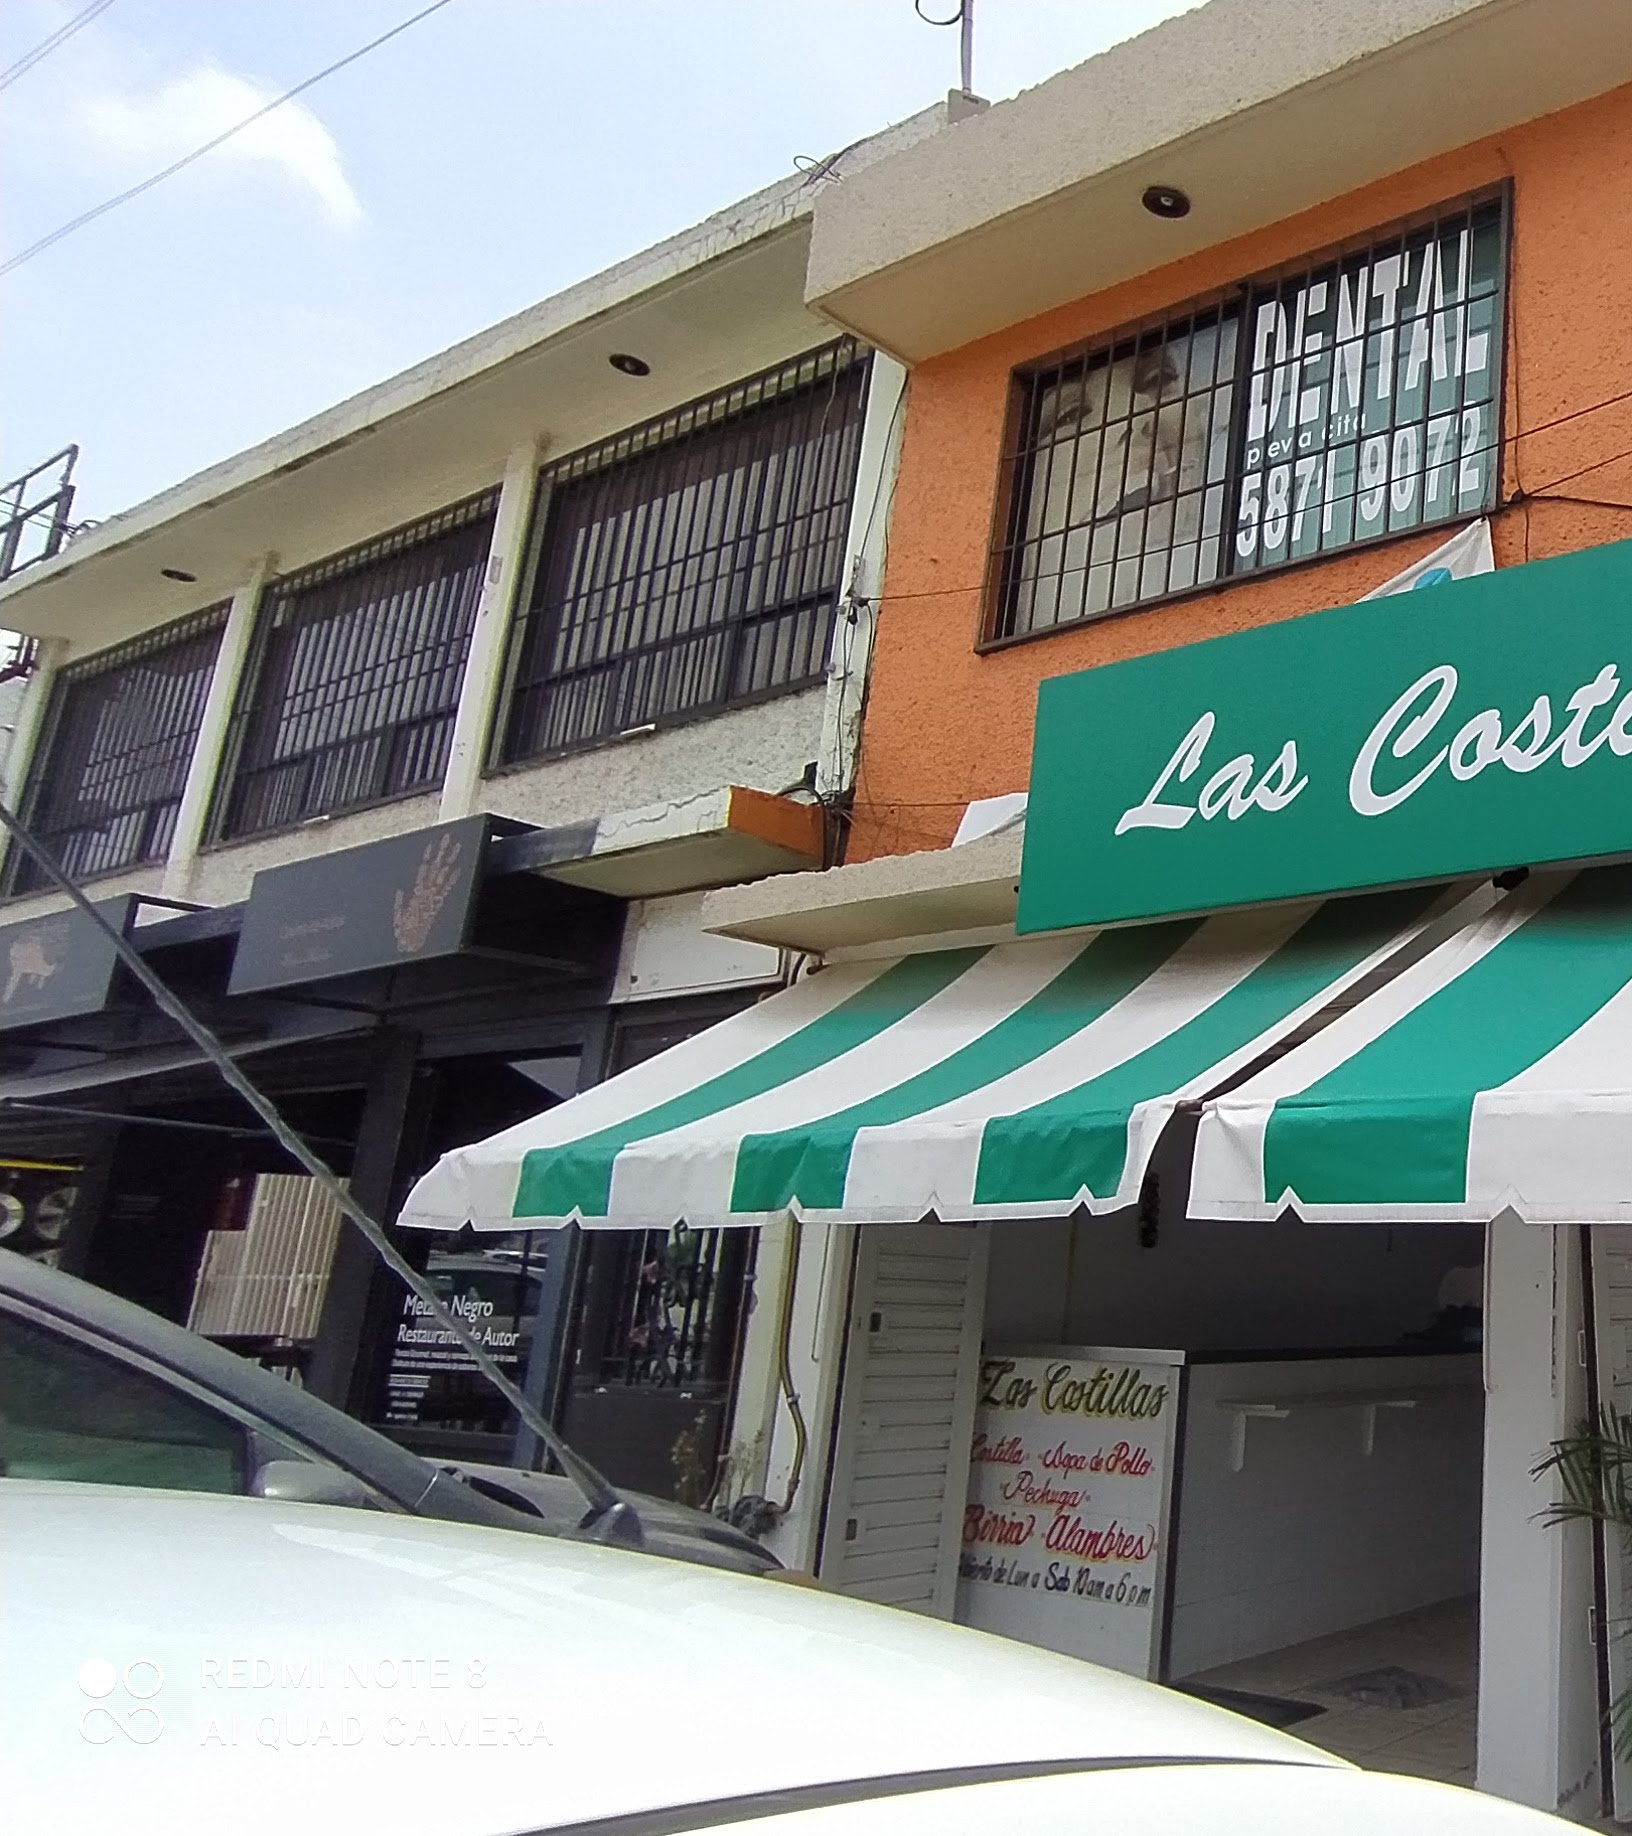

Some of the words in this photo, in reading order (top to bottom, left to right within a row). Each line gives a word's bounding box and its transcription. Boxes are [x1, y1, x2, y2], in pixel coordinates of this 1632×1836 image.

[1247, 228, 1489, 443] DENTAL
[1246, 428, 1312, 469] peva
[1321, 412, 1366, 440] cita
[1235, 446, 1337, 558] 5871
[1359, 402, 1482, 522] 9072
[1113, 710, 1309, 836] Las
[450, 1295, 494, 1323] Negro
[481, 1326, 520, 1347] Autor
[981, 1360, 1039, 1407] Las
[1043, 1362, 1170, 1419] Costillas
[1105, 1441, 1153, 1476] Pollo
[1003, 1470, 1087, 1513] Pechuga
[963, 1504, 1036, 1546] Birria
[1045, 1514, 1156, 1561] Alambres
